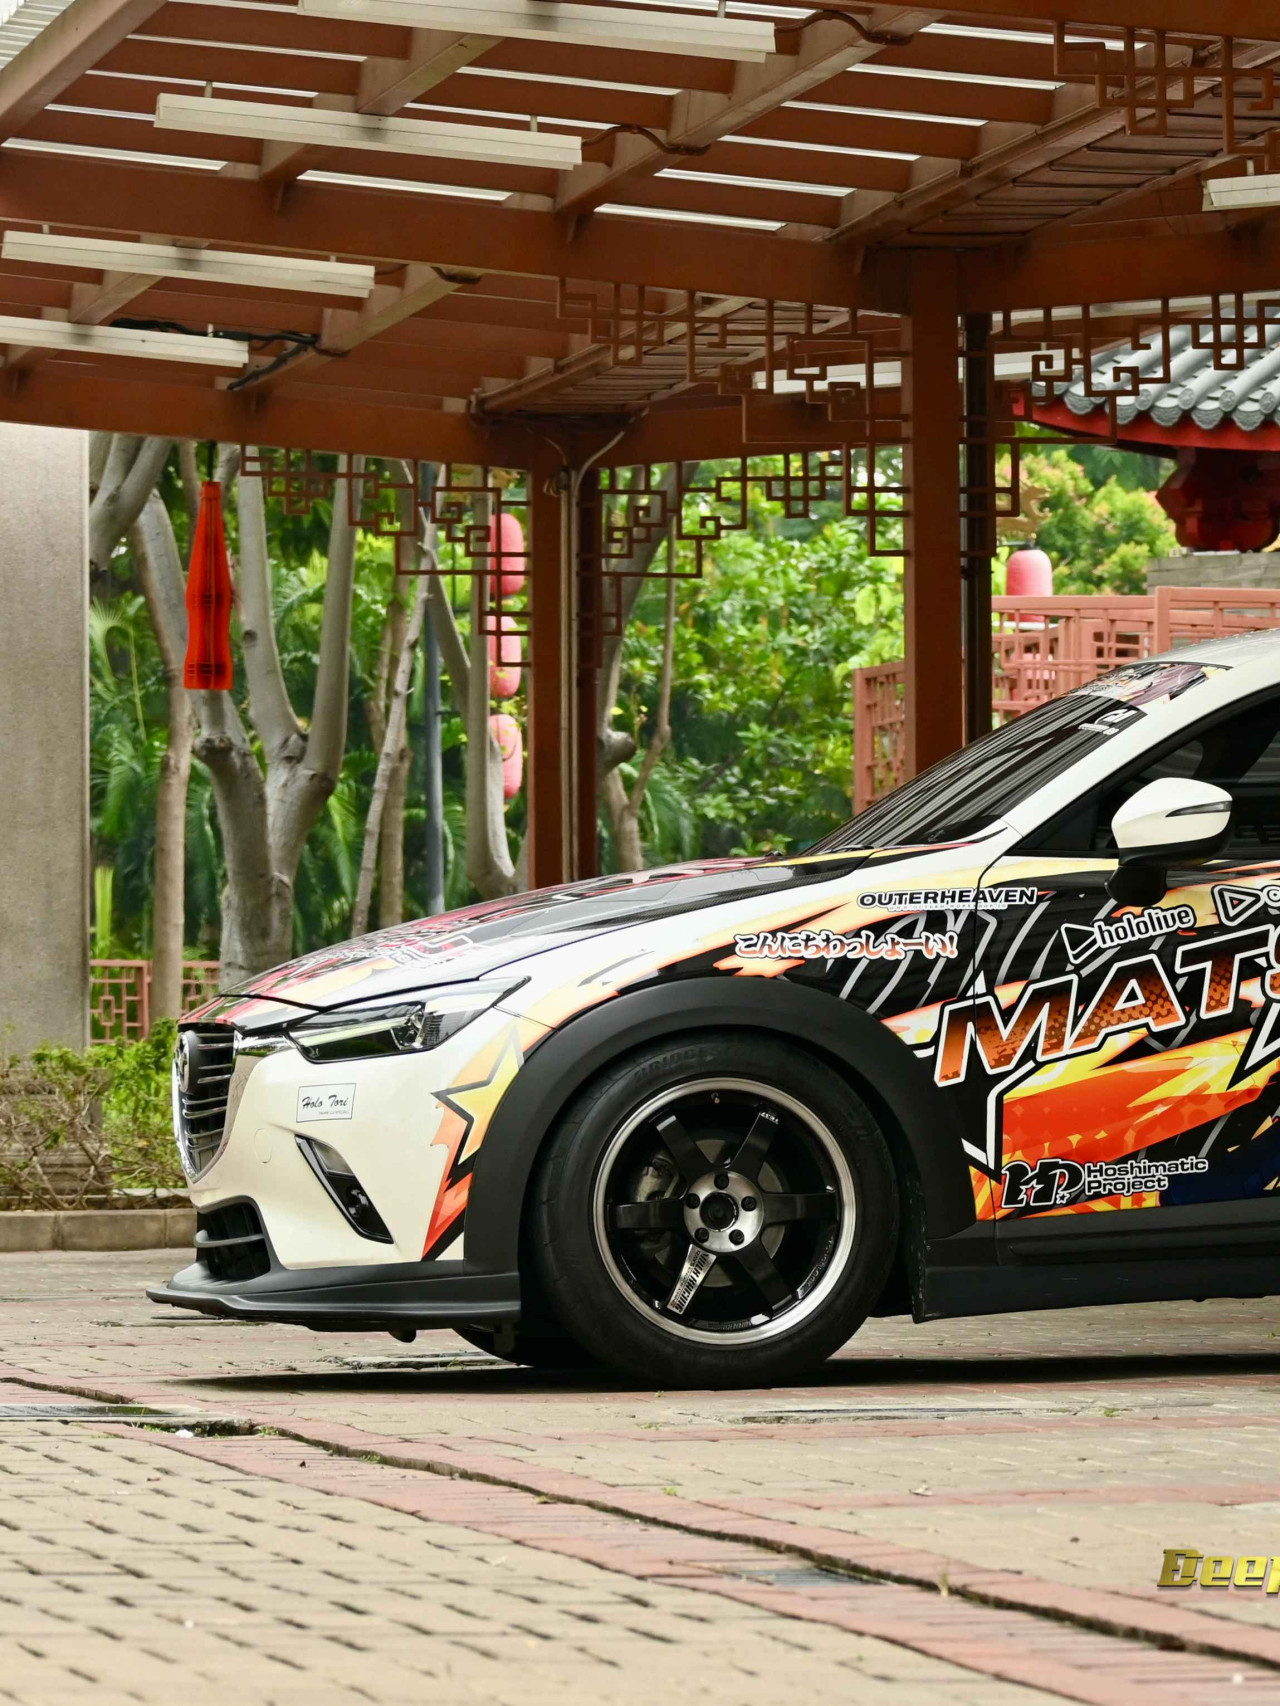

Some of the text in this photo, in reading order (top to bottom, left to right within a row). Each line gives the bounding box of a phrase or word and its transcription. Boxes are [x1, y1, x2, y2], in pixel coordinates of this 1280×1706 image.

[858, 888, 1037, 907] OUTERHEAVEN
[1098, 908, 1193, 946] hololive
[302, 1094, 349, 1109] Holo Tori
[1086, 1156, 1208, 1179] Hoshimatic
[1086, 1176, 1168, 1196] Project
